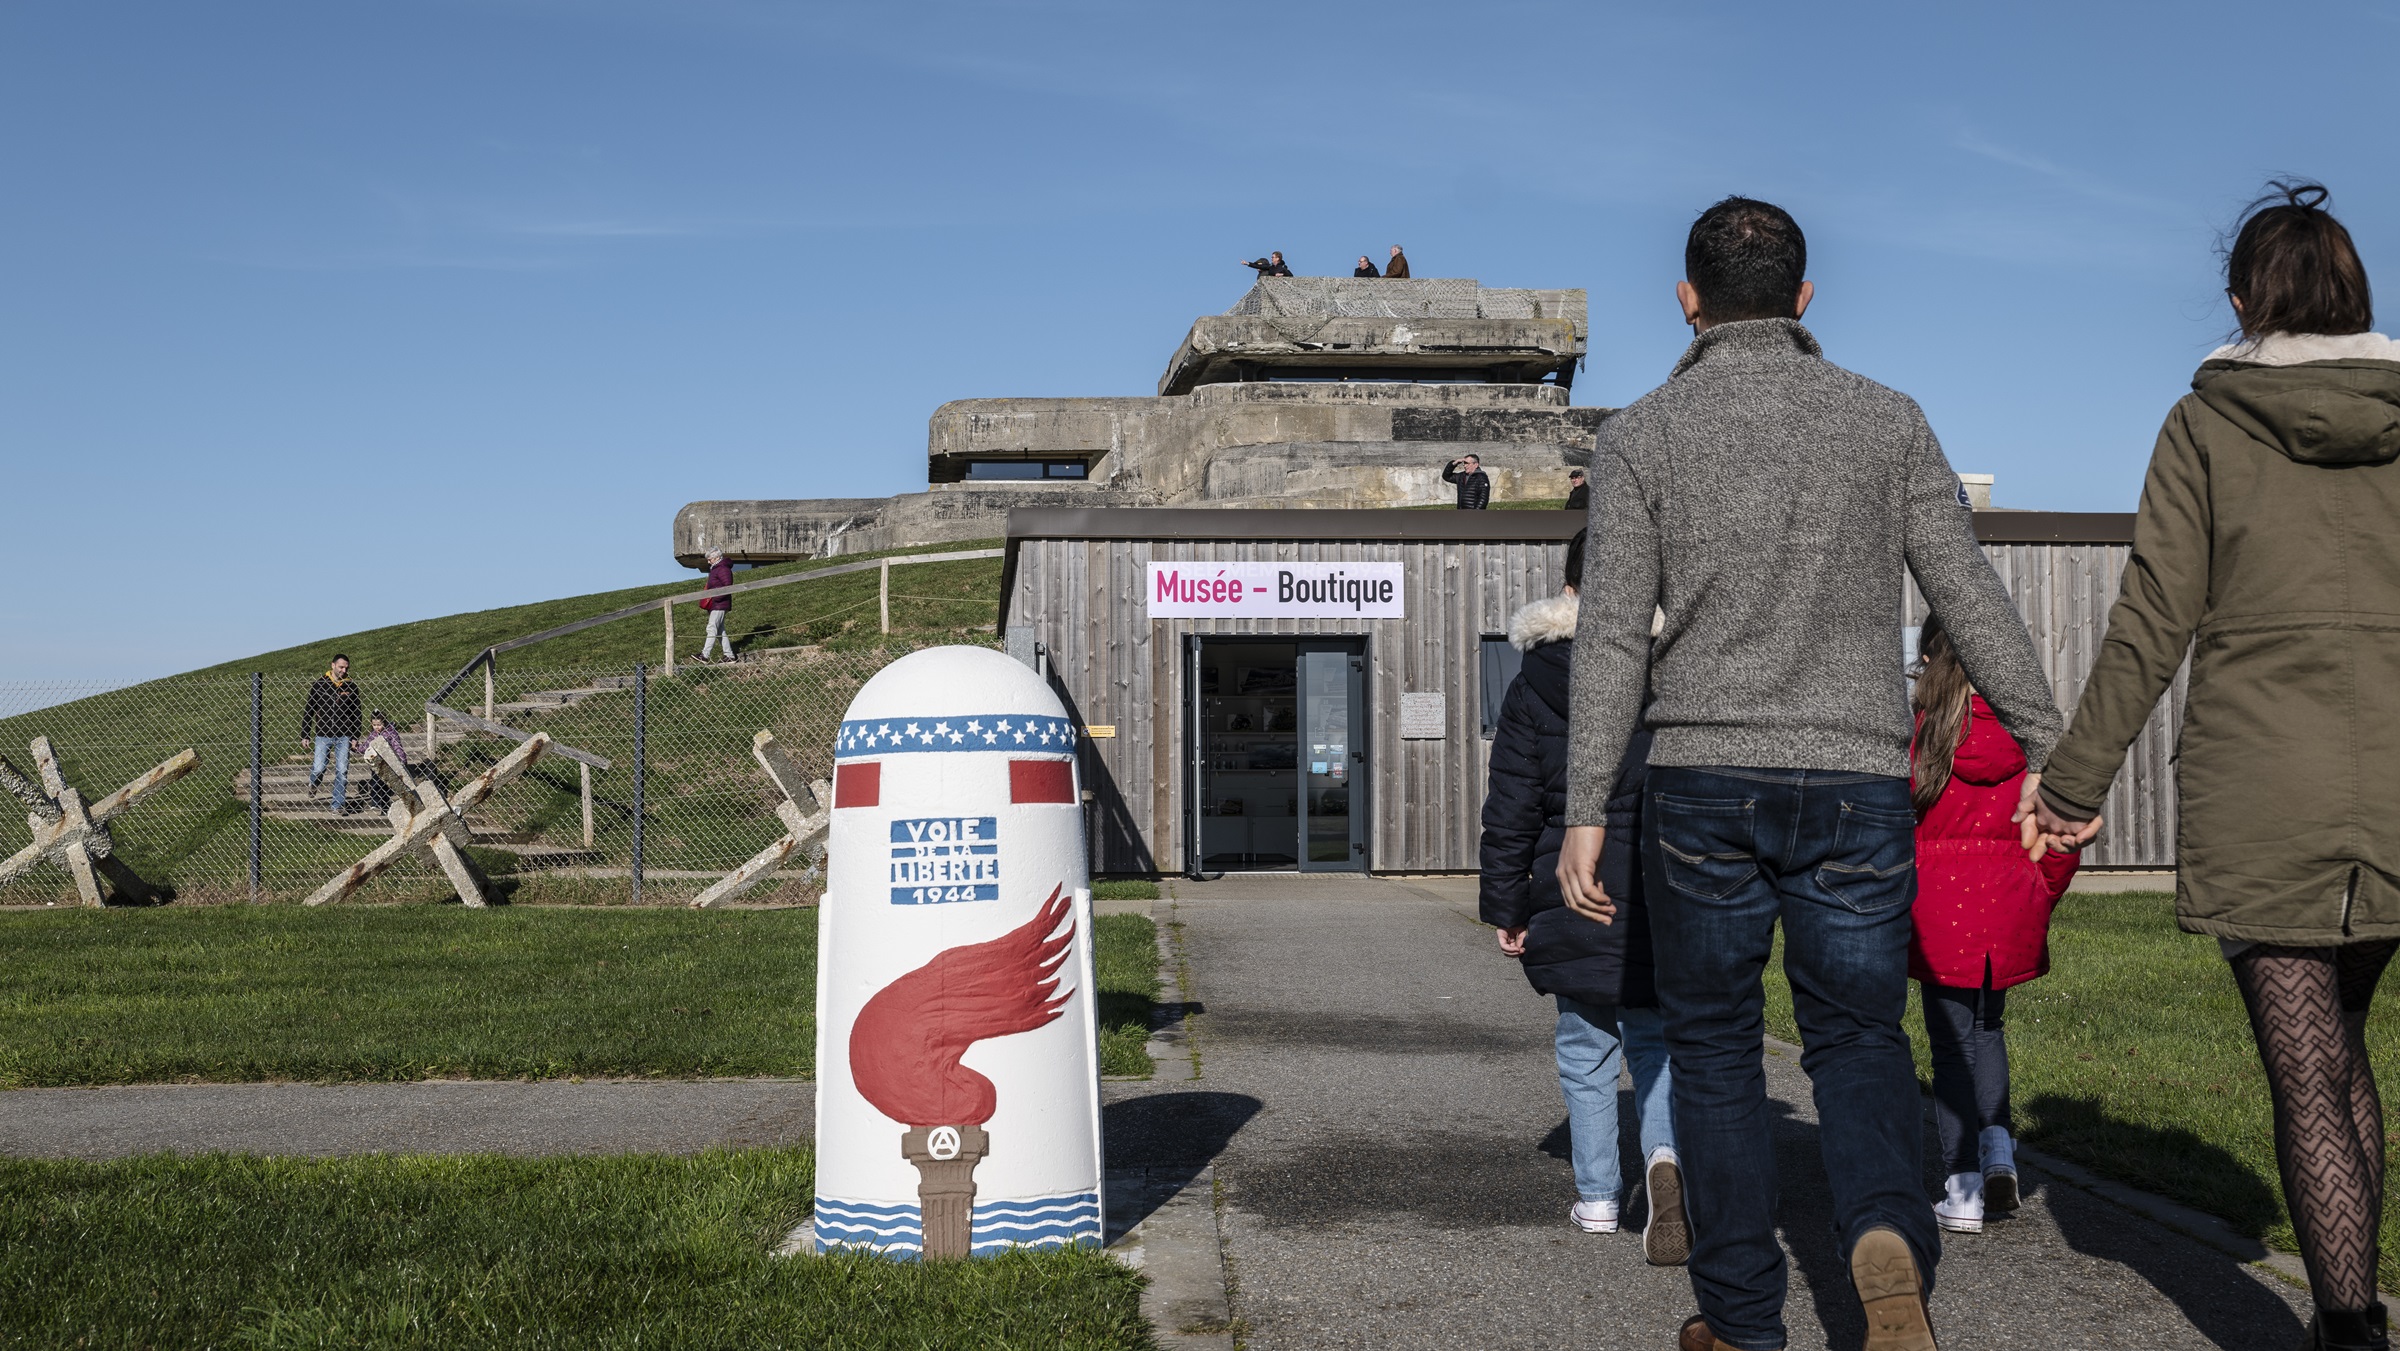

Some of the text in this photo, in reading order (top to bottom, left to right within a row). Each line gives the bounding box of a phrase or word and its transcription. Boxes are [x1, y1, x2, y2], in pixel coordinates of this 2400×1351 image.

[1157, 570, 1243, 603] Musée
[1278, 570, 1393, 611] Boutique
[906, 818, 980, 842] VOIE
[915, 845, 973, 857] DE LA
[895, 860, 996, 882] LIBERTE
[912, 886, 977, 904] 1944
